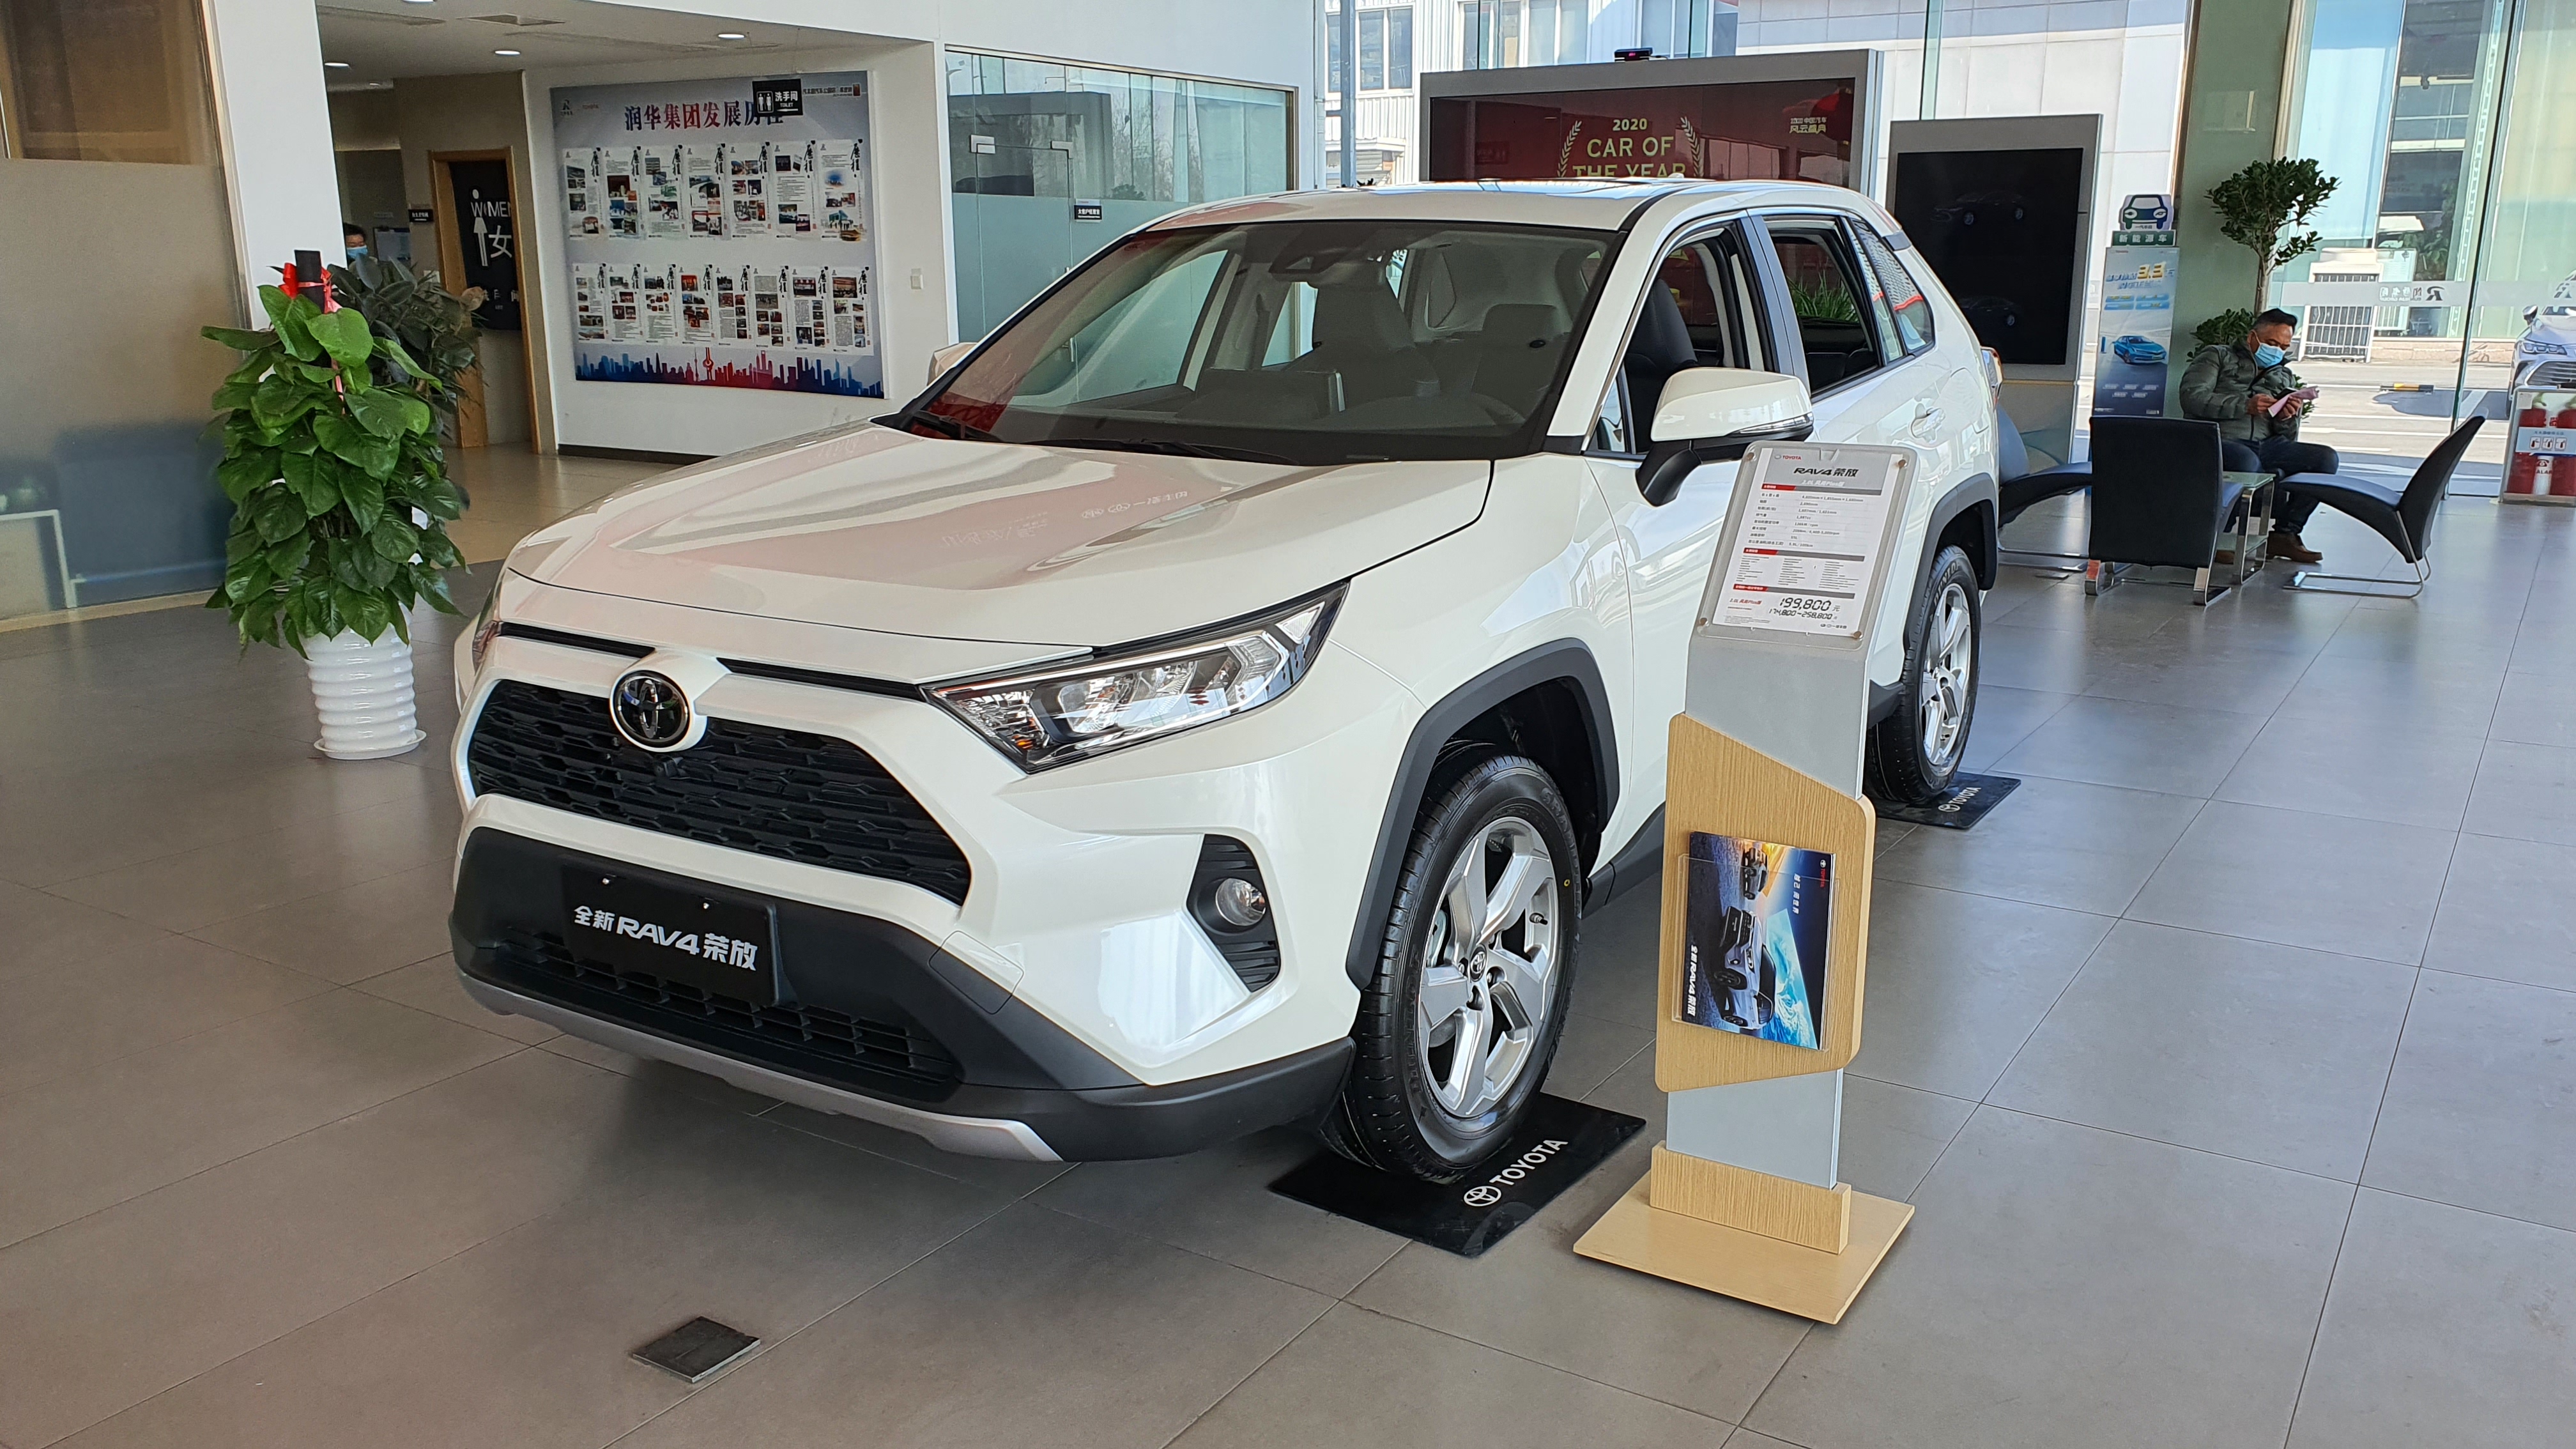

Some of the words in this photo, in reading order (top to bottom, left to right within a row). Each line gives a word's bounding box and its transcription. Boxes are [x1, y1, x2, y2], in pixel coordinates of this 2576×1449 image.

[774, 91, 798, 102] 洗手间
[1613, 118, 1648, 131] 2020
[1587, 138, 1633, 158] CAR
[1643, 136, 1674, 157] OF
[1572, 164, 1618, 177] THE
[1625, 163, 1686, 178] YEAR
[489, 225, 512, 257] 女
[2119, 234, 2167, 243] 新能源车
[1793, 468, 1859, 477] RAV4荣放
[1780, 597, 1832, 611] 199,800
[1948, 787, 1981, 804] TOYOTA
[574, 905, 758, 971] 全新RAV4荣放
[1489, 1140, 1568, 1185] TOYOTA
